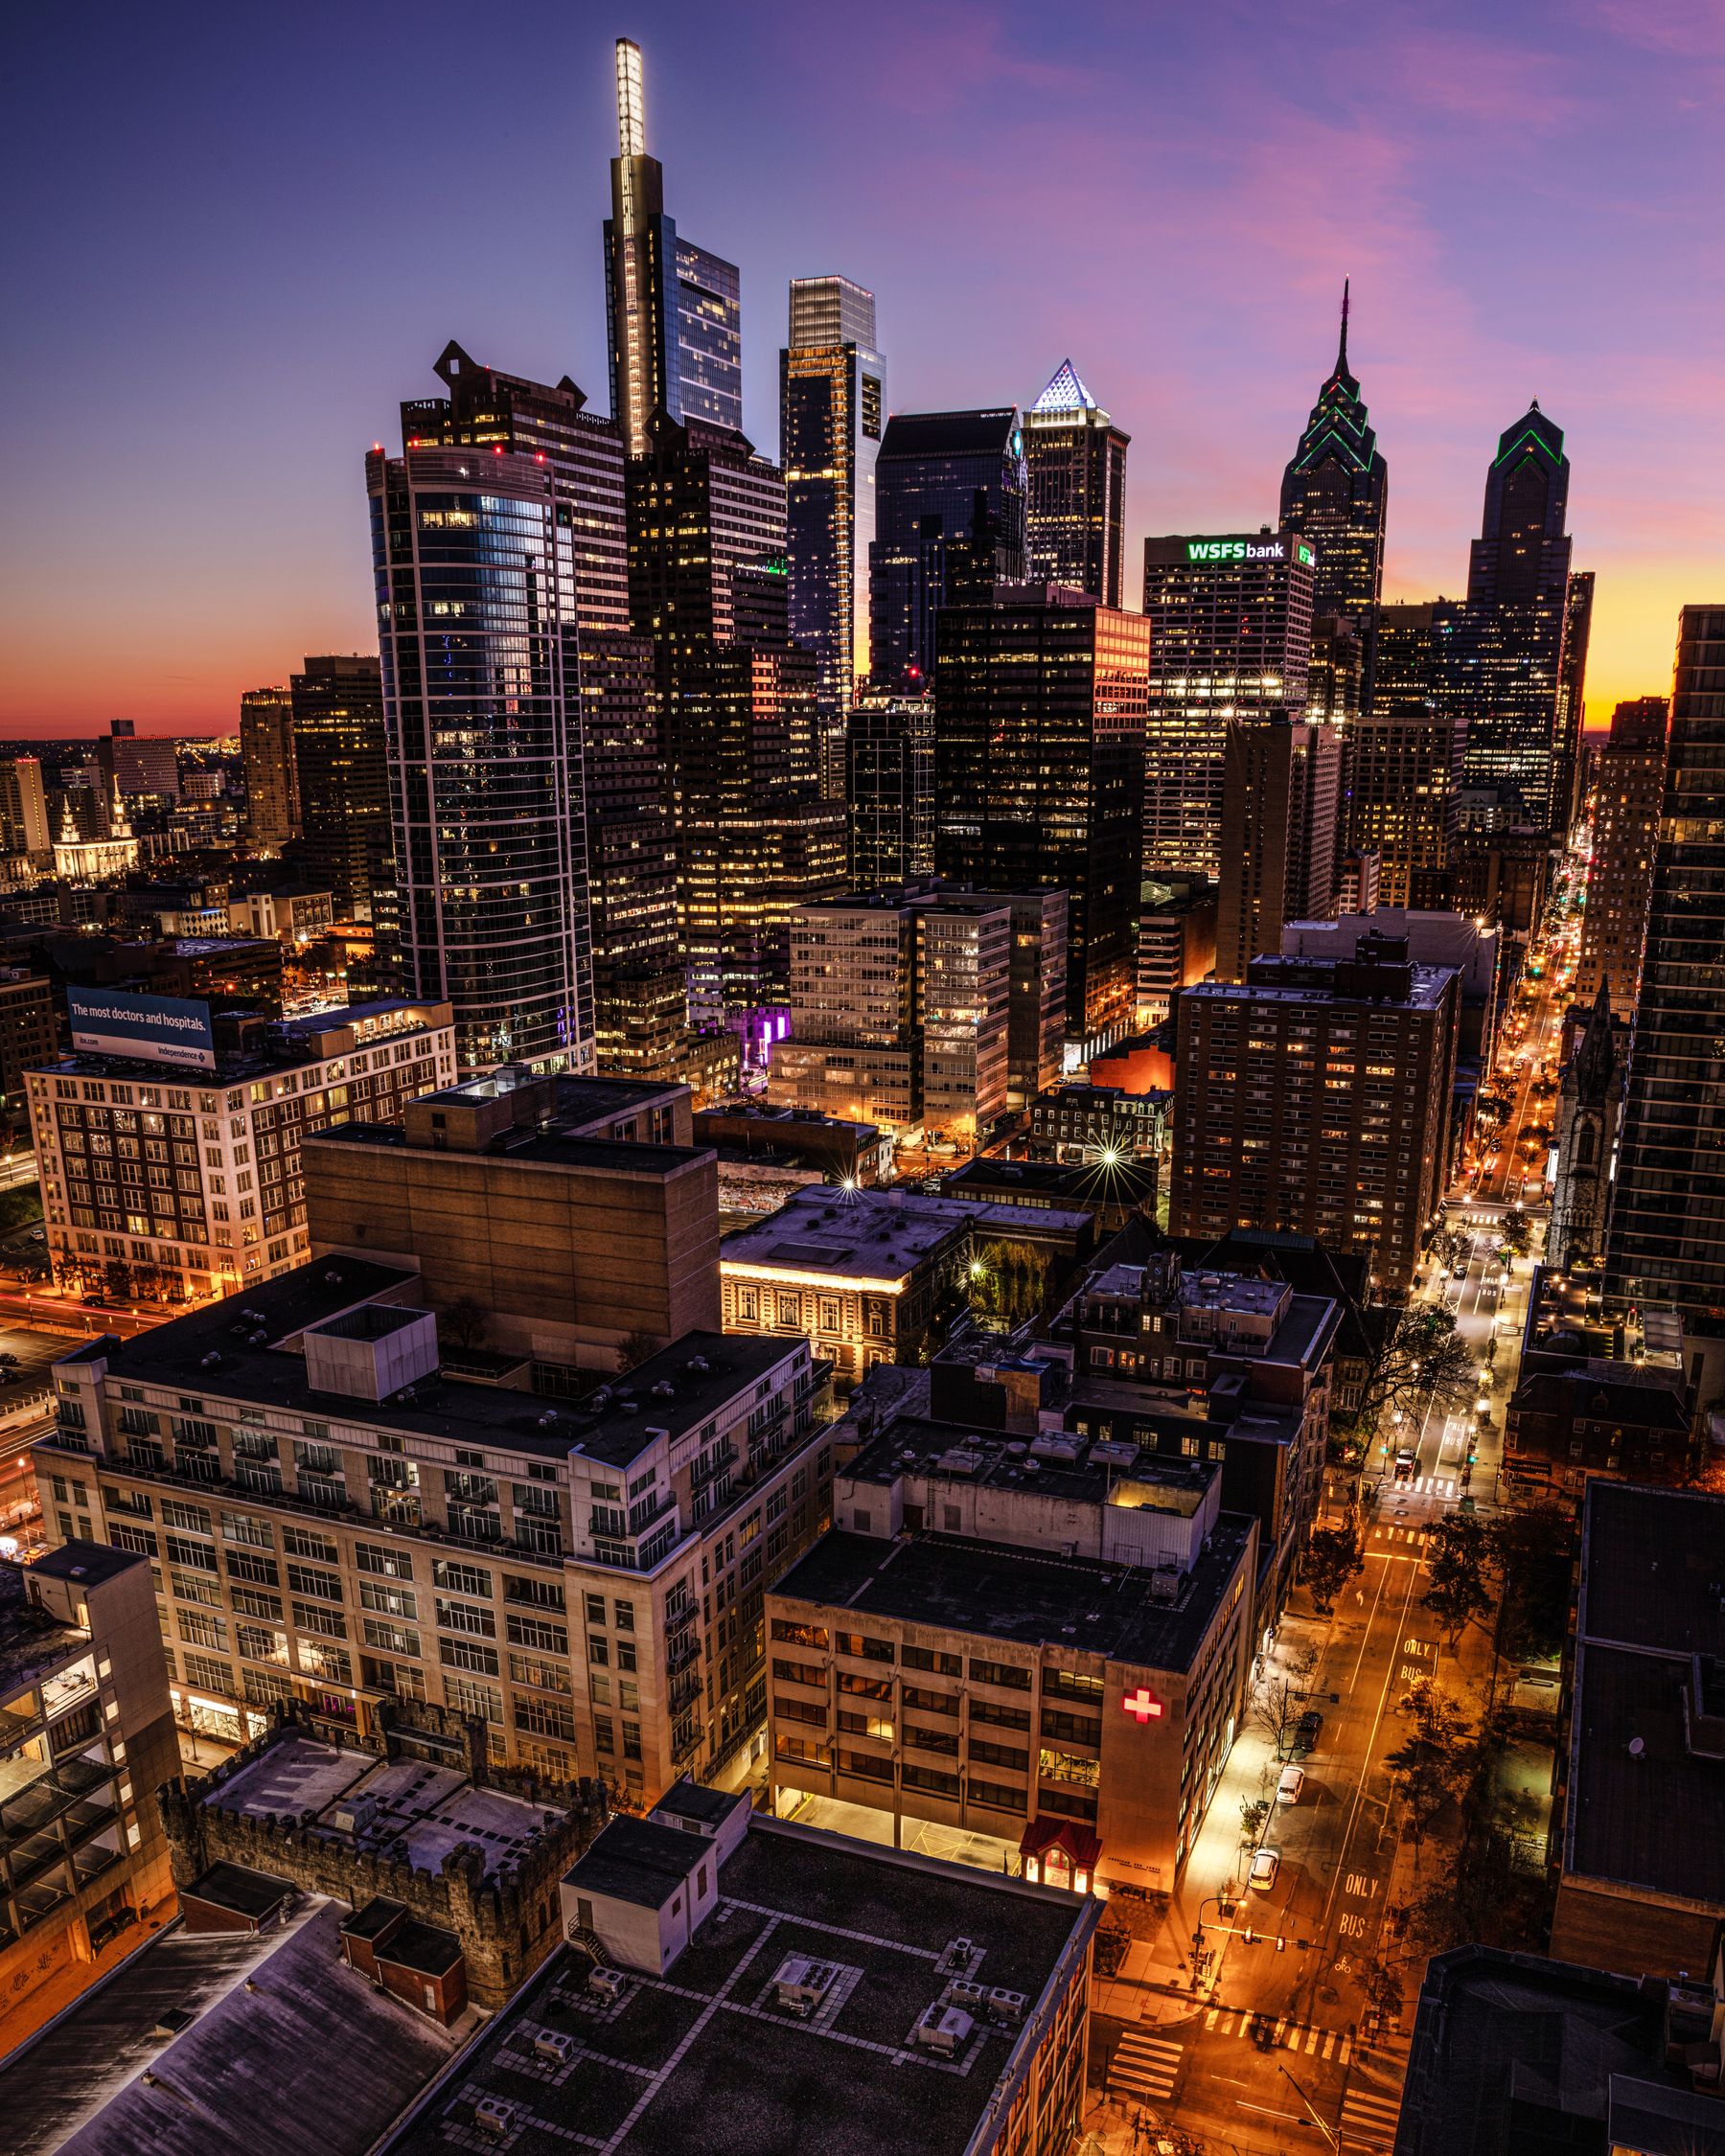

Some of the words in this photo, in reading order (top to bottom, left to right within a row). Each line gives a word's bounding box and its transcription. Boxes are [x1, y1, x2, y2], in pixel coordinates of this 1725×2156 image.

[1188, 542, 1245, 560] WSFS
[1246, 542, 1284, 558] bank
[71, 1003, 88, 1016] The
[89, 1007, 110, 1019] most
[112, 1007, 144, 1022] doctors
[146, 1012, 162, 1025] and
[163, 1013, 206, 1031] hospitals.
[80, 1037, 99, 1045] ibx.com
[158, 1046, 197, 1060] Independence
[1444, 1435, 1461, 1447] BUS
[1404, 1640, 1430, 1656] ONLY
[1346, 1873, 1378, 1898] ONLY
[1339, 1913, 1366, 1938] BUS
